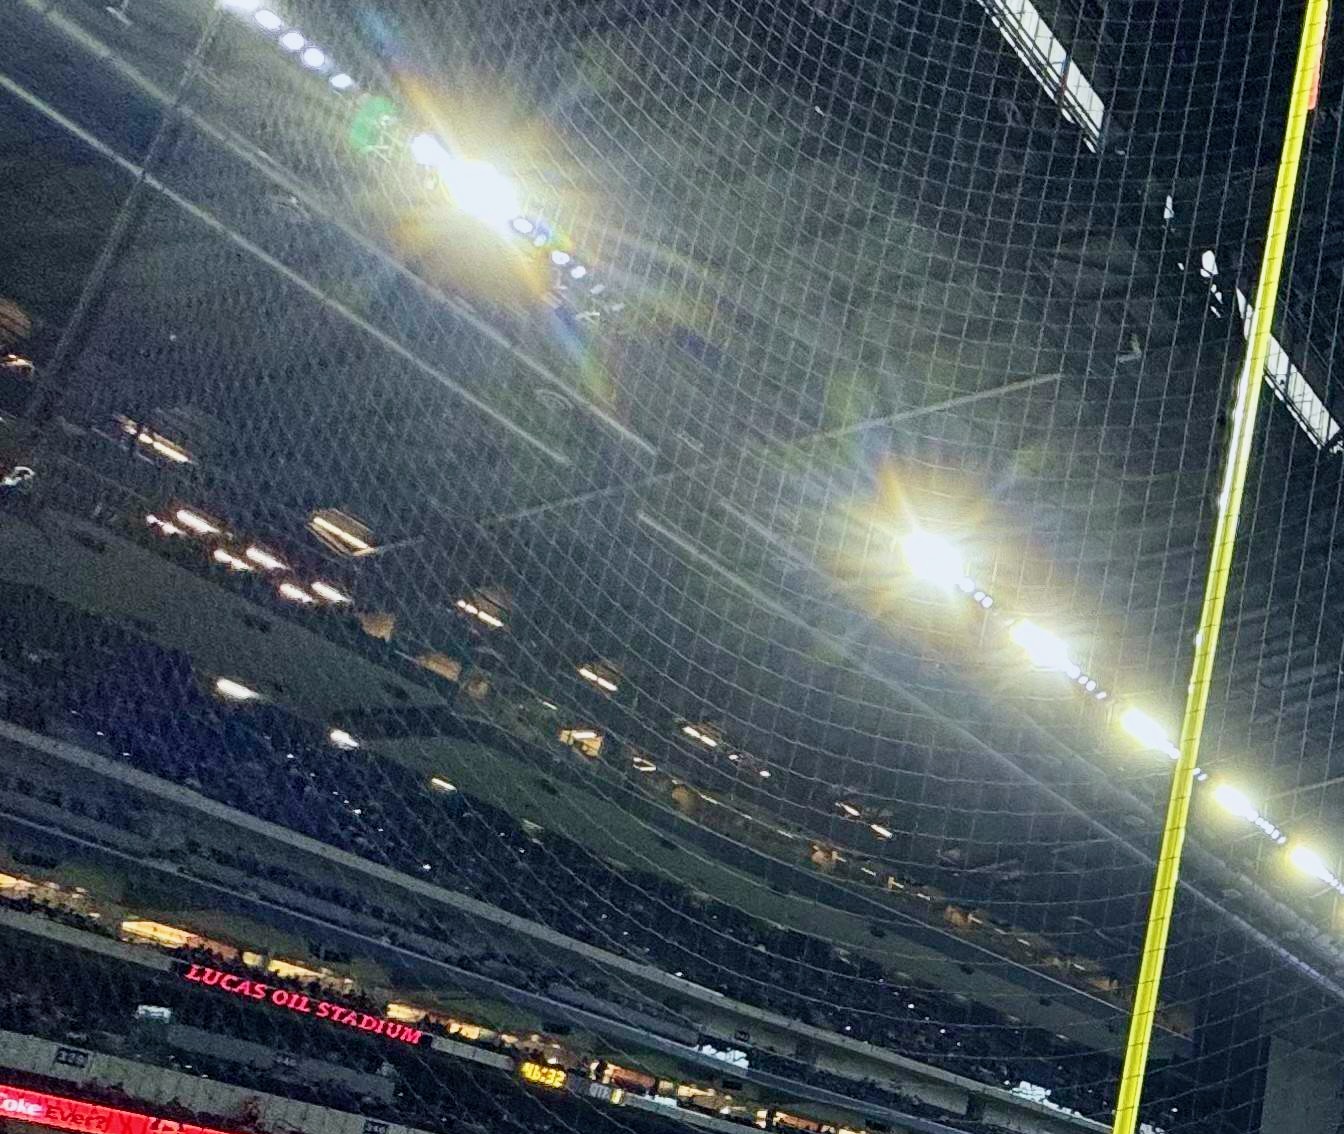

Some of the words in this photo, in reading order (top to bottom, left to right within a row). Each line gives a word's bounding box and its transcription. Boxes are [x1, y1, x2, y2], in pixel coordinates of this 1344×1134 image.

[185, 963, 268, 1000] LUCAS
[271, 990, 311, 1013] OIL
[315, 1002, 423, 1045] STADIUM
